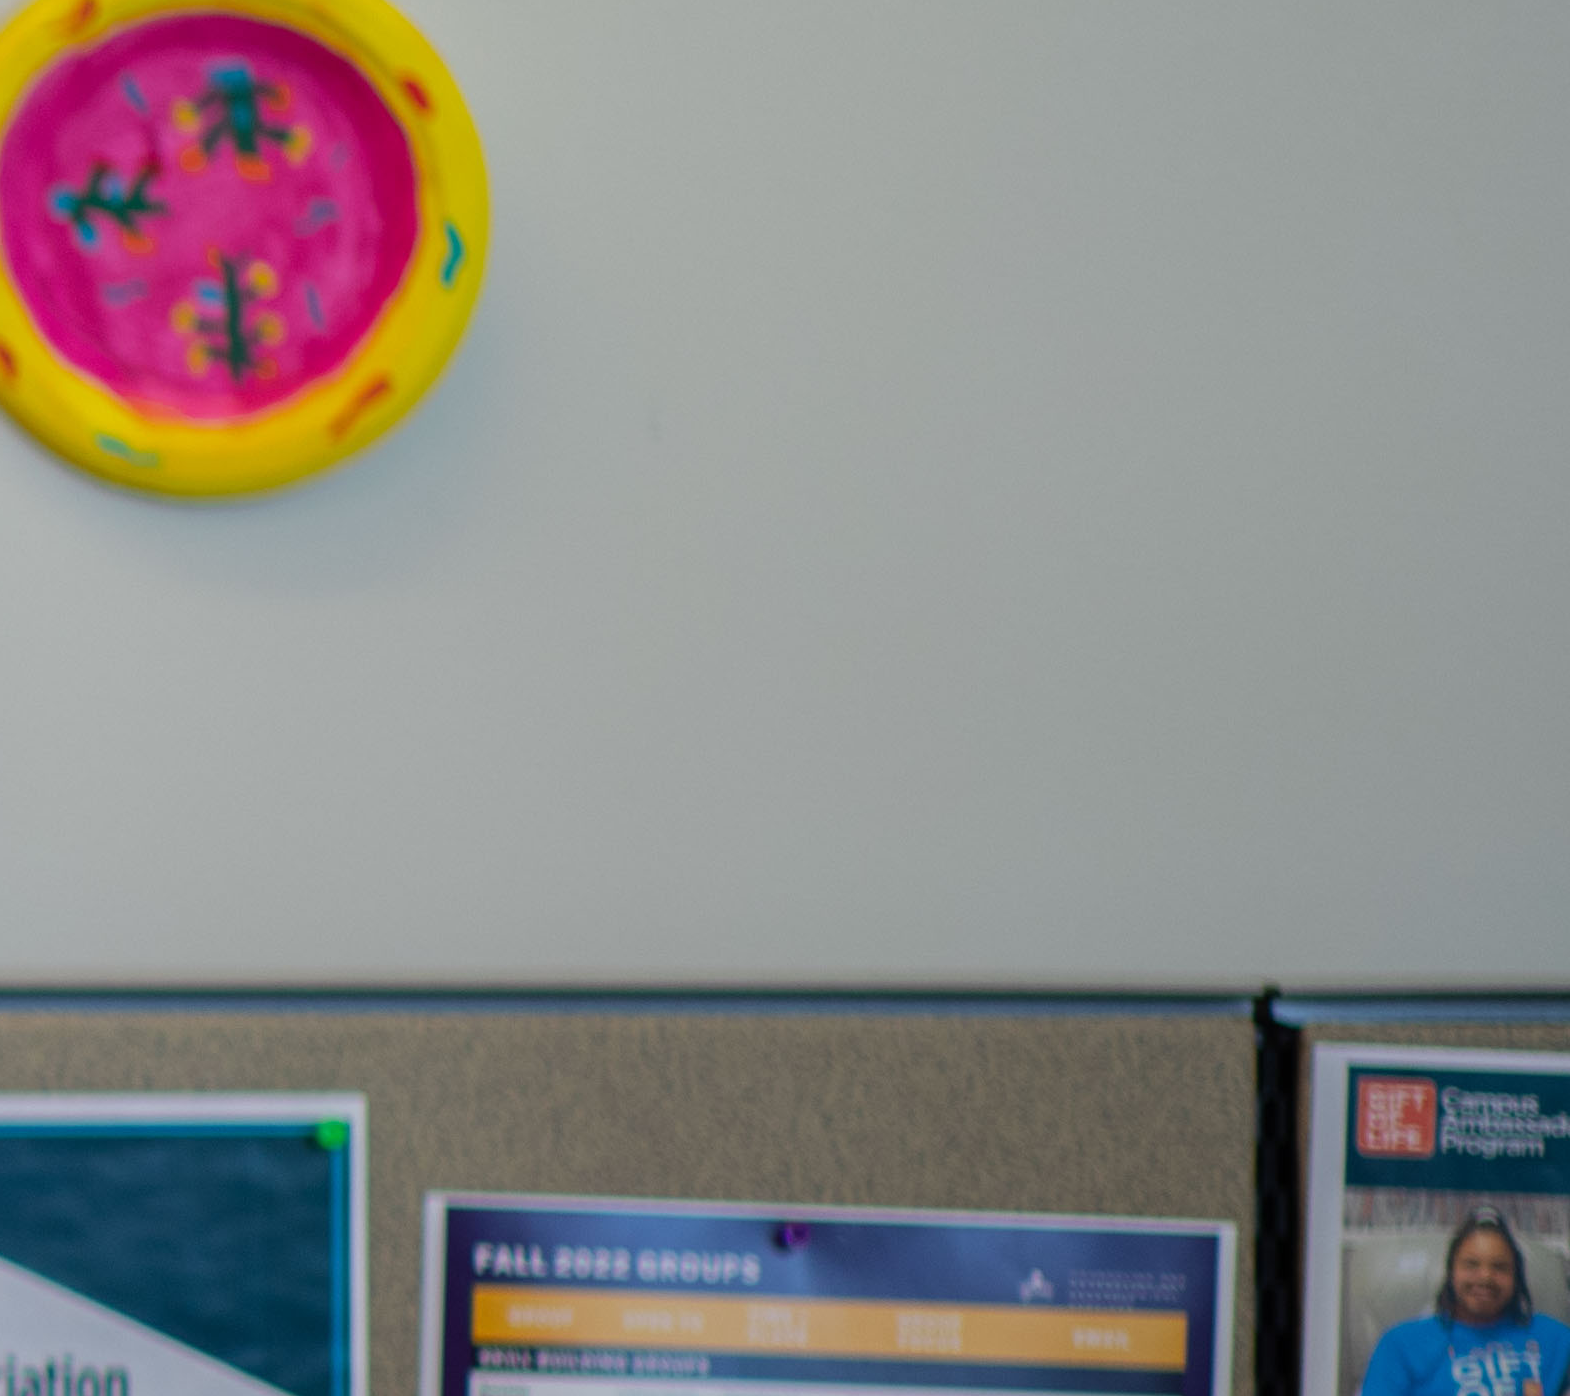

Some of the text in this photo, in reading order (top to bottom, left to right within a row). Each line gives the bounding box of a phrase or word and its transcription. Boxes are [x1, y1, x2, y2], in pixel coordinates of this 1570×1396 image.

[1442, 1086, 1539, 1119] Campus
[1442, 1132, 1545, 1161] Program
[473, 1241, 548, 1278] FALL
[636, 1248, 763, 1288] GROUPS
